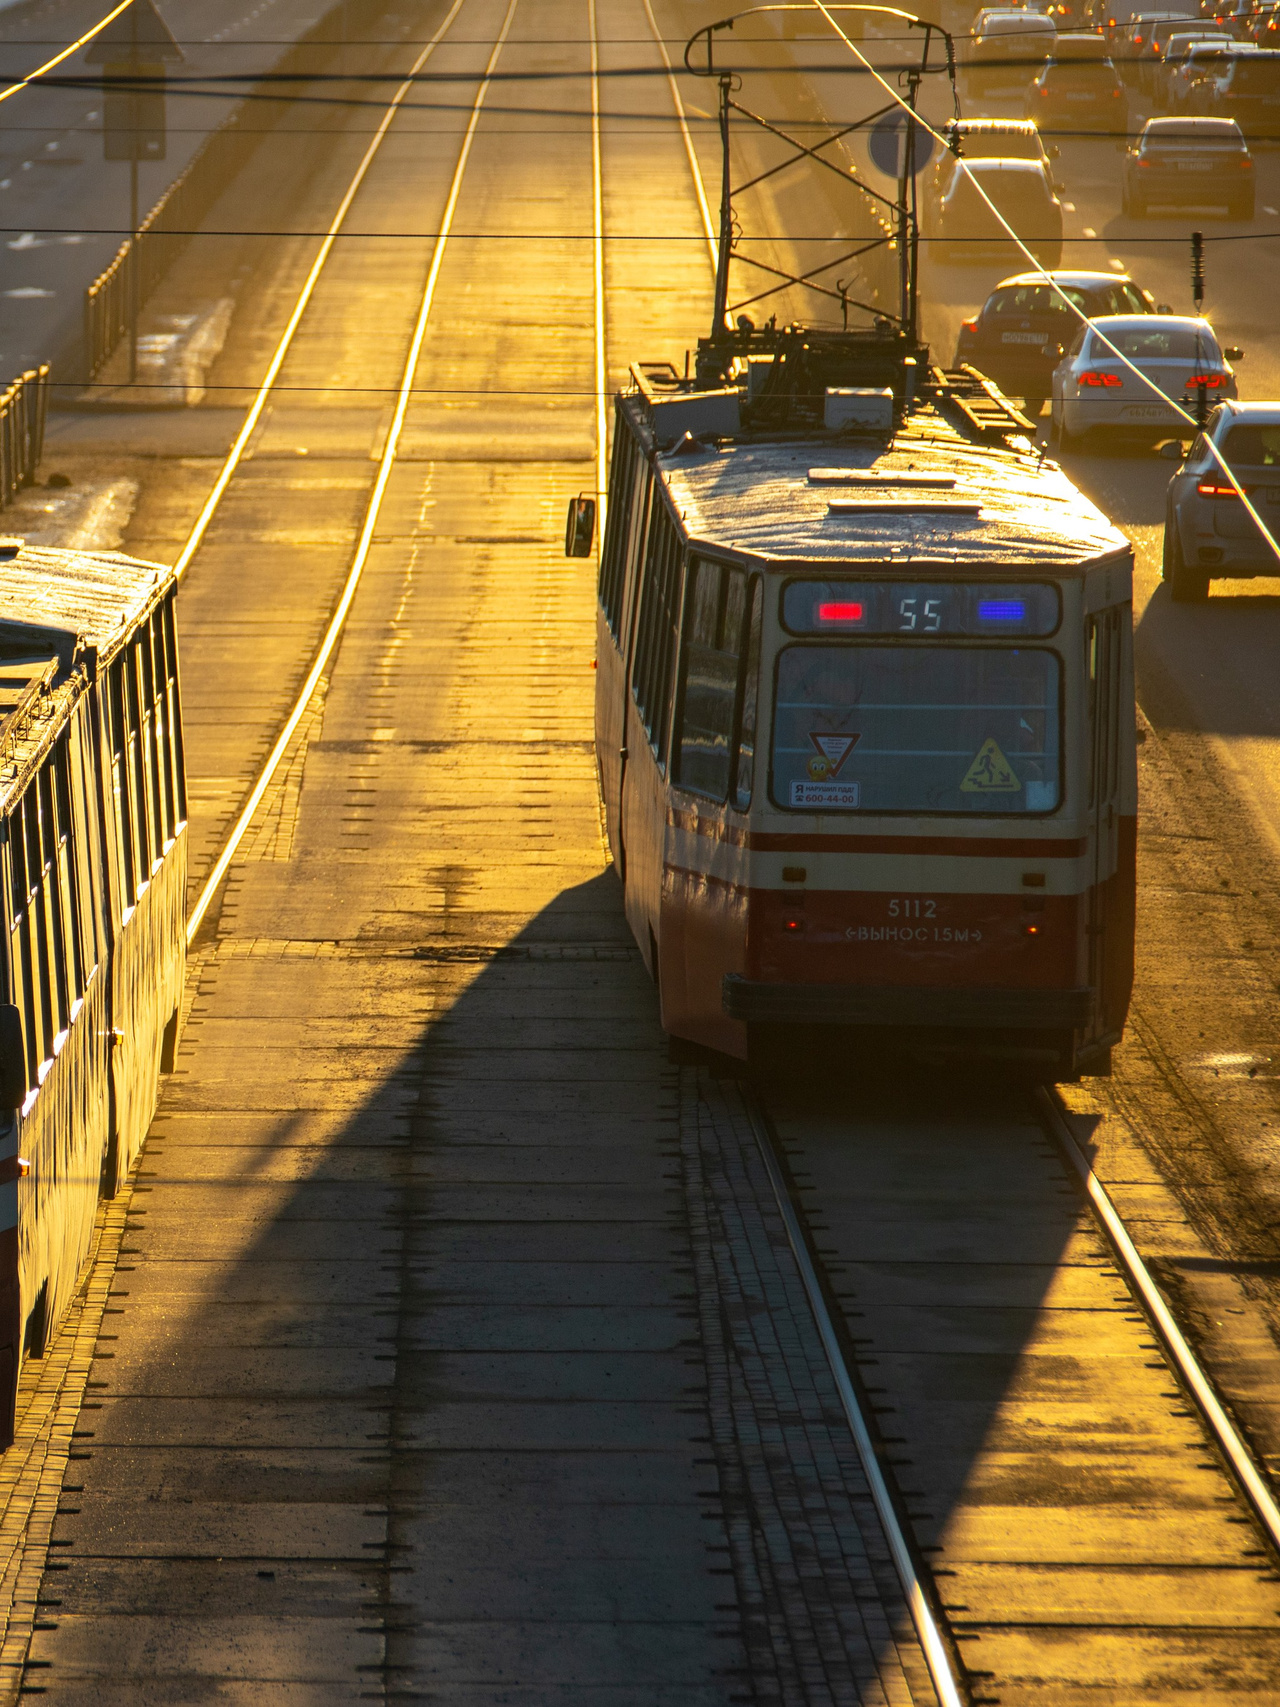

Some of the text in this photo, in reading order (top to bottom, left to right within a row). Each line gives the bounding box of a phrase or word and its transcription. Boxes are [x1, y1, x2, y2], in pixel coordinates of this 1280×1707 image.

[899, 598, 942, 631] 55
[795, 784, 804, 793] Я
[805, 794, 854, 803] 600-44-00
[888, 899, 937, 918] 5112
[858, 926, 929, 941] ВЫНОС
